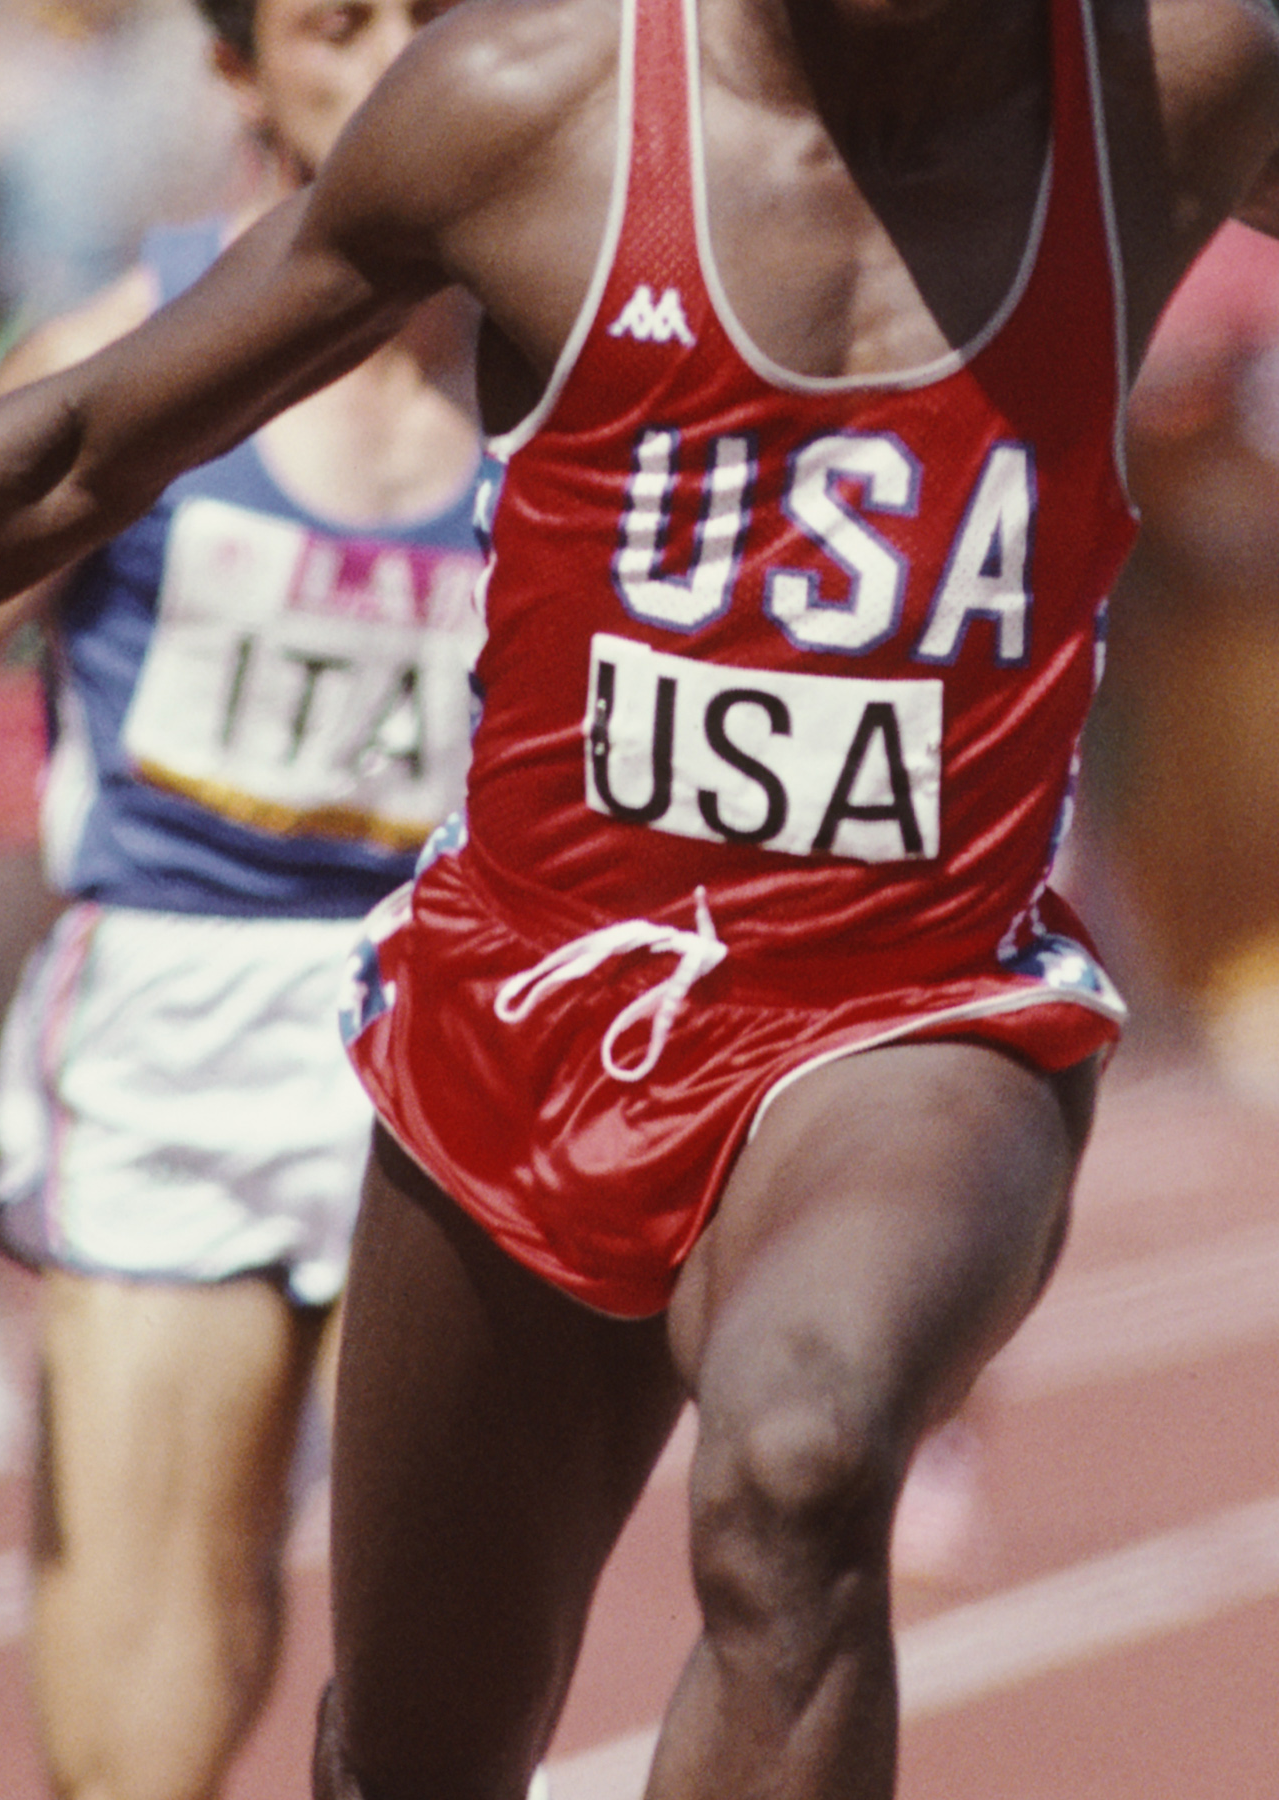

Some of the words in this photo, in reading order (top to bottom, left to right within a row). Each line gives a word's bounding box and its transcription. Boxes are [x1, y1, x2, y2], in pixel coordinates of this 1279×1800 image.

[609, 426, 1039, 668] USA
[219, 630, 429, 780] ITA
[589, 660, 925, 855] USA
